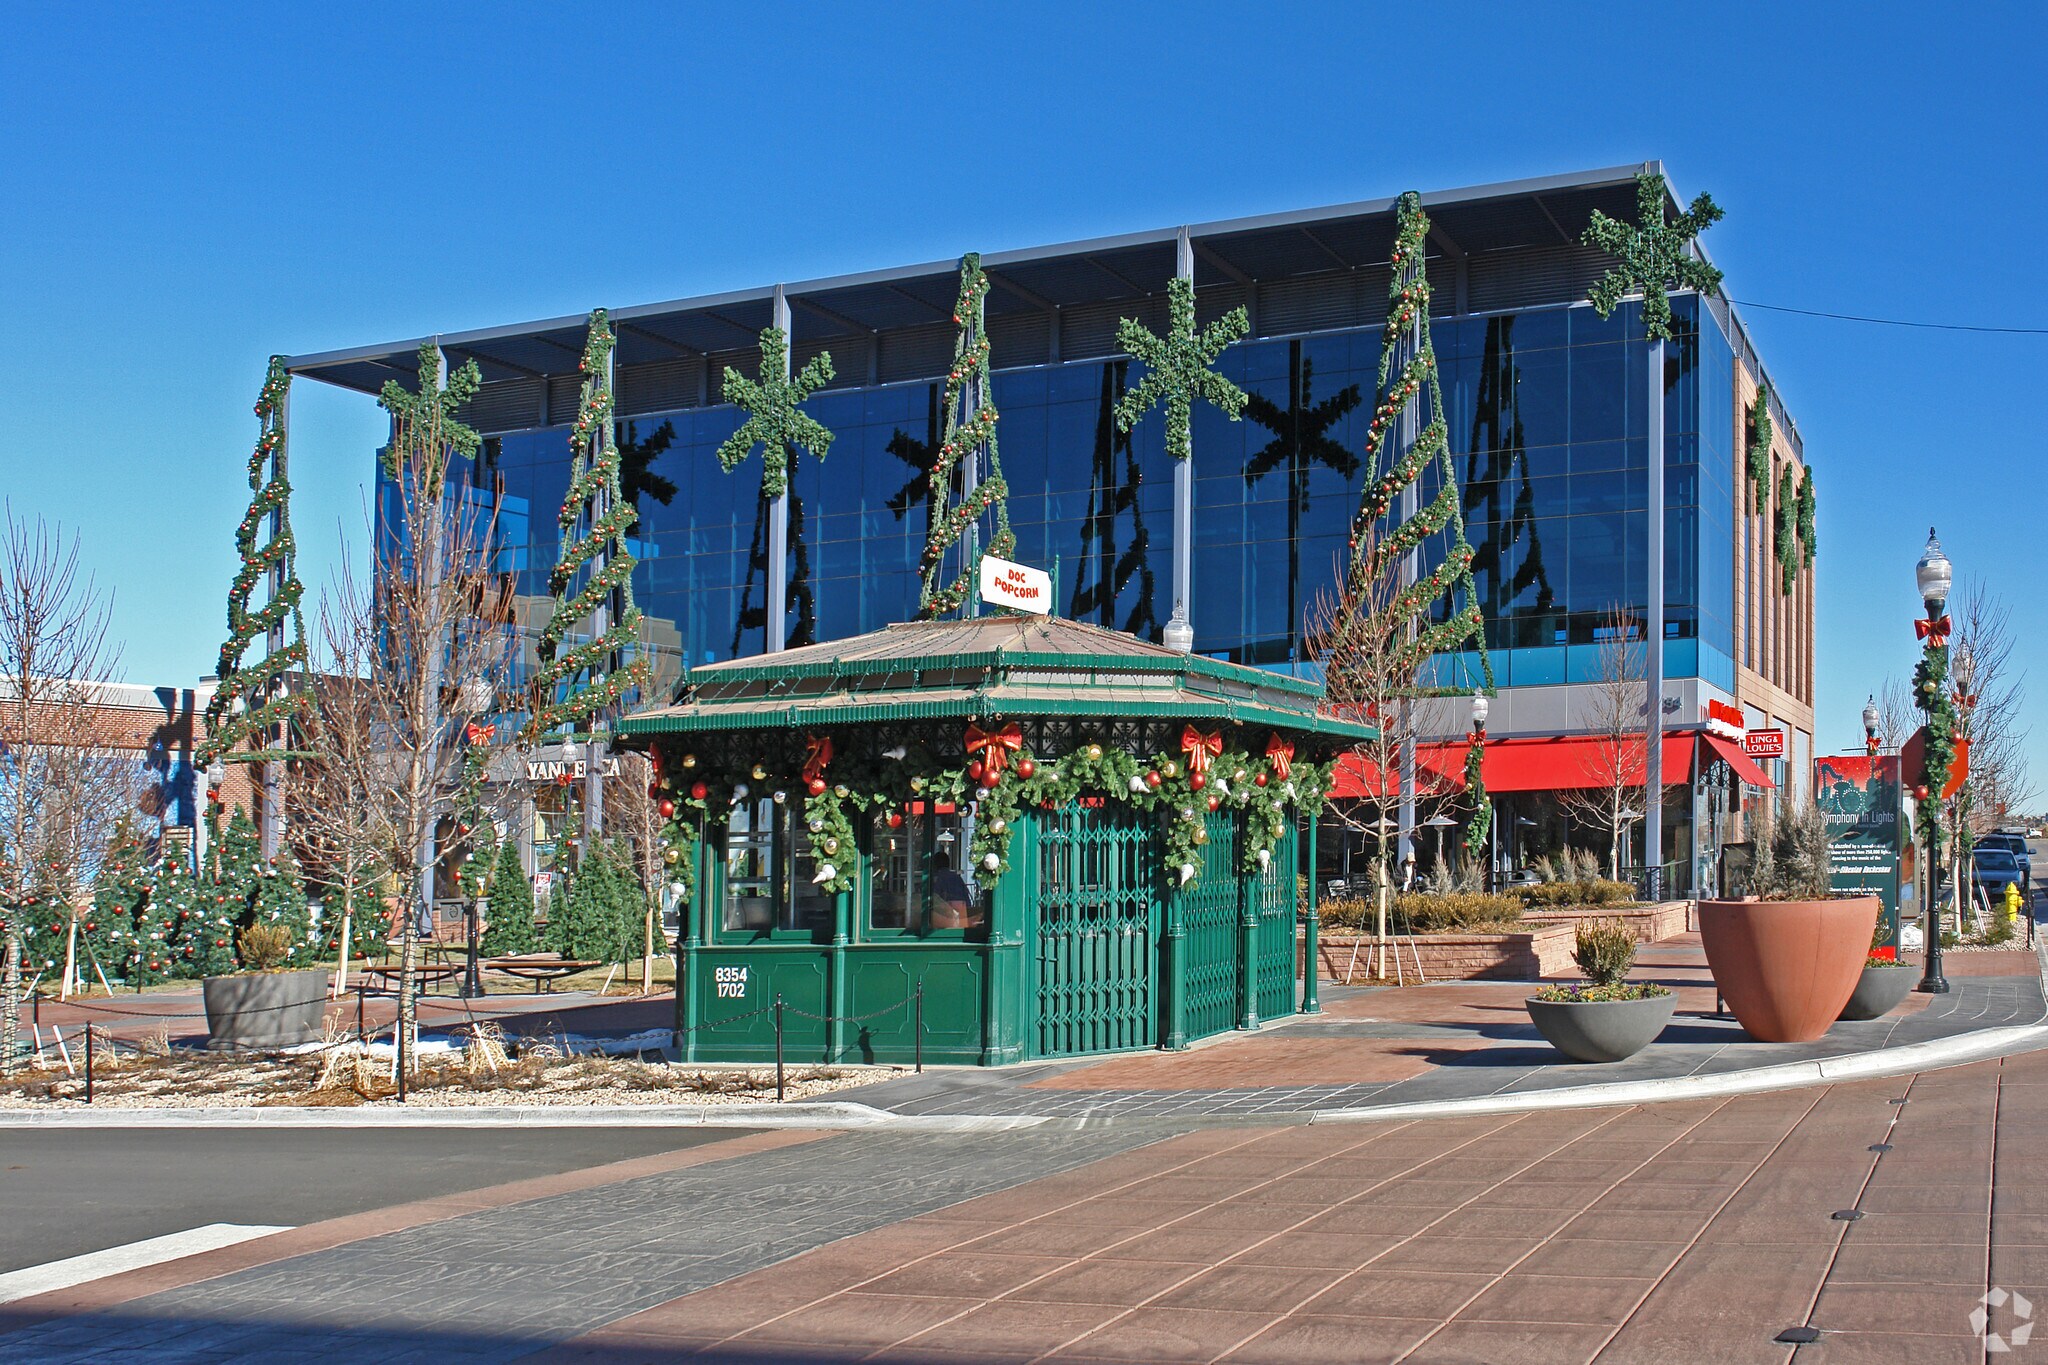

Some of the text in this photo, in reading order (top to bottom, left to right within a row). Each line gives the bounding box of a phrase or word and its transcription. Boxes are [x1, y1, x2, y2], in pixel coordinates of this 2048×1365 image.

[1008, 569, 1026, 584] DOC
[994, 576, 1039, 599] POPCORN
[1746, 743, 1782, 752] LOUIE'S
[1820, 810, 1895, 826] Symphony In Lights
[715, 967, 748, 982] 8354
[717, 982, 746, 998] 1702
